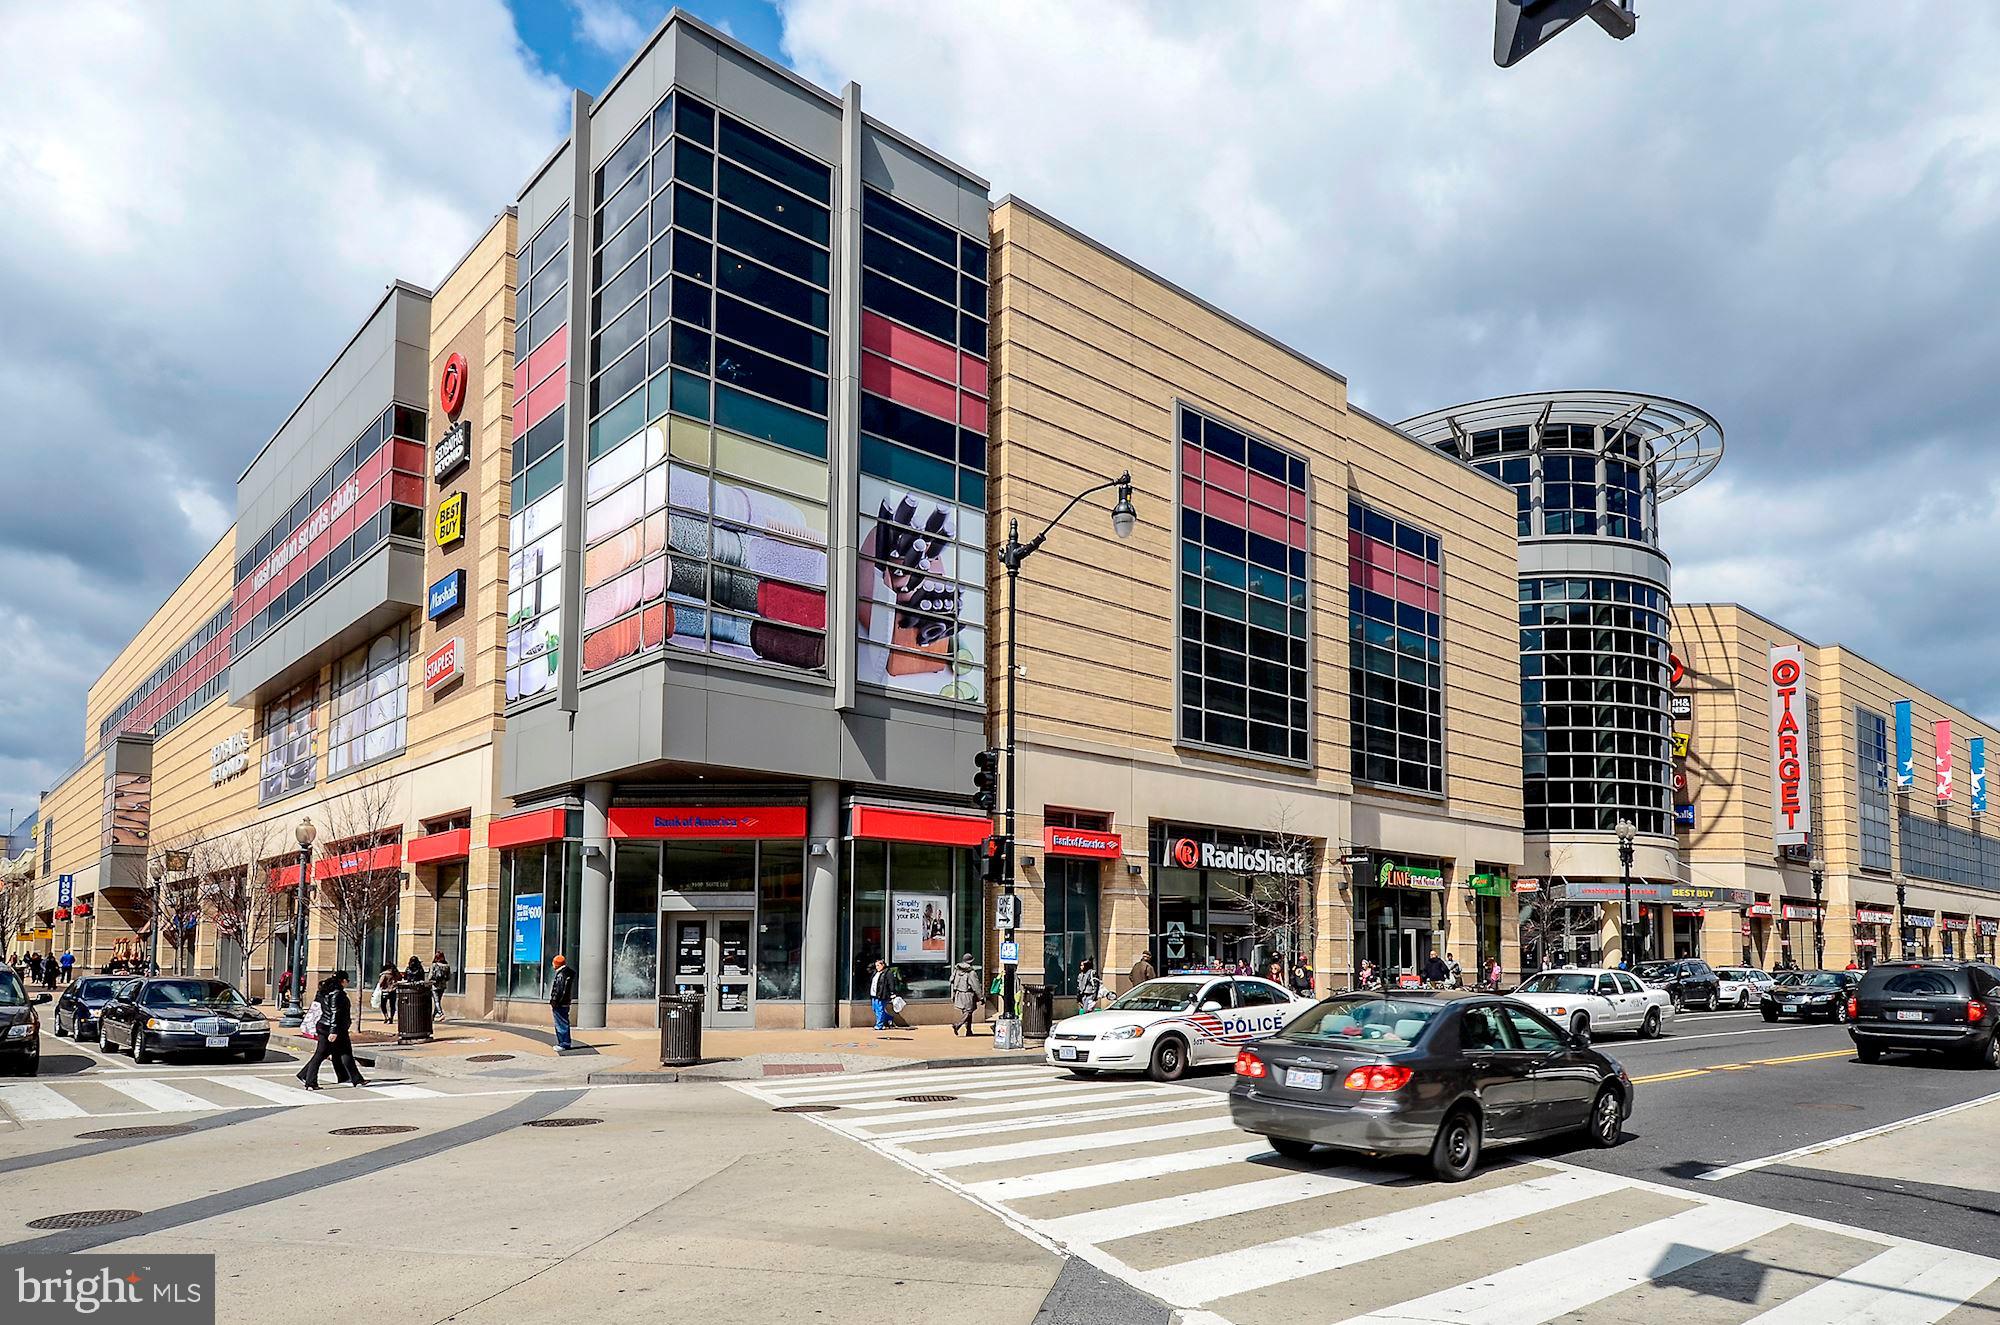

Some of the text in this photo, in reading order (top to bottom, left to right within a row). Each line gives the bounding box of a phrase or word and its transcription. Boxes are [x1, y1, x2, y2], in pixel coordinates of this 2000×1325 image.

[435, 444, 464, 477] BEYOND
[298, 507, 328, 554] sports
[331, 478, 359, 521] clubs
[440, 502, 460, 524] BEST
[440, 519, 457, 539] BUY
[430, 580, 457, 611] Marshalls
[426, 649, 454, 681] STAPLES
[1777, 687, 1802, 831] TARGET
[654, 816, 681, 828] Bank
[695, 816, 737, 828] America
[1053, 835, 1071, 847] Bank
[1079, 837, 1106, 849] America
[1201, 842, 1305, 875] RadioShack
[1387, 870, 1411, 887] LIME
[60, 875, 71, 904] IHOP
[1671, 888, 1715, 898] BEST BUY
[896, 899, 920, 908] Simplify
[999, 897, 1011, 906] ONE
[1223, 1015, 1284, 1035] POLICE
